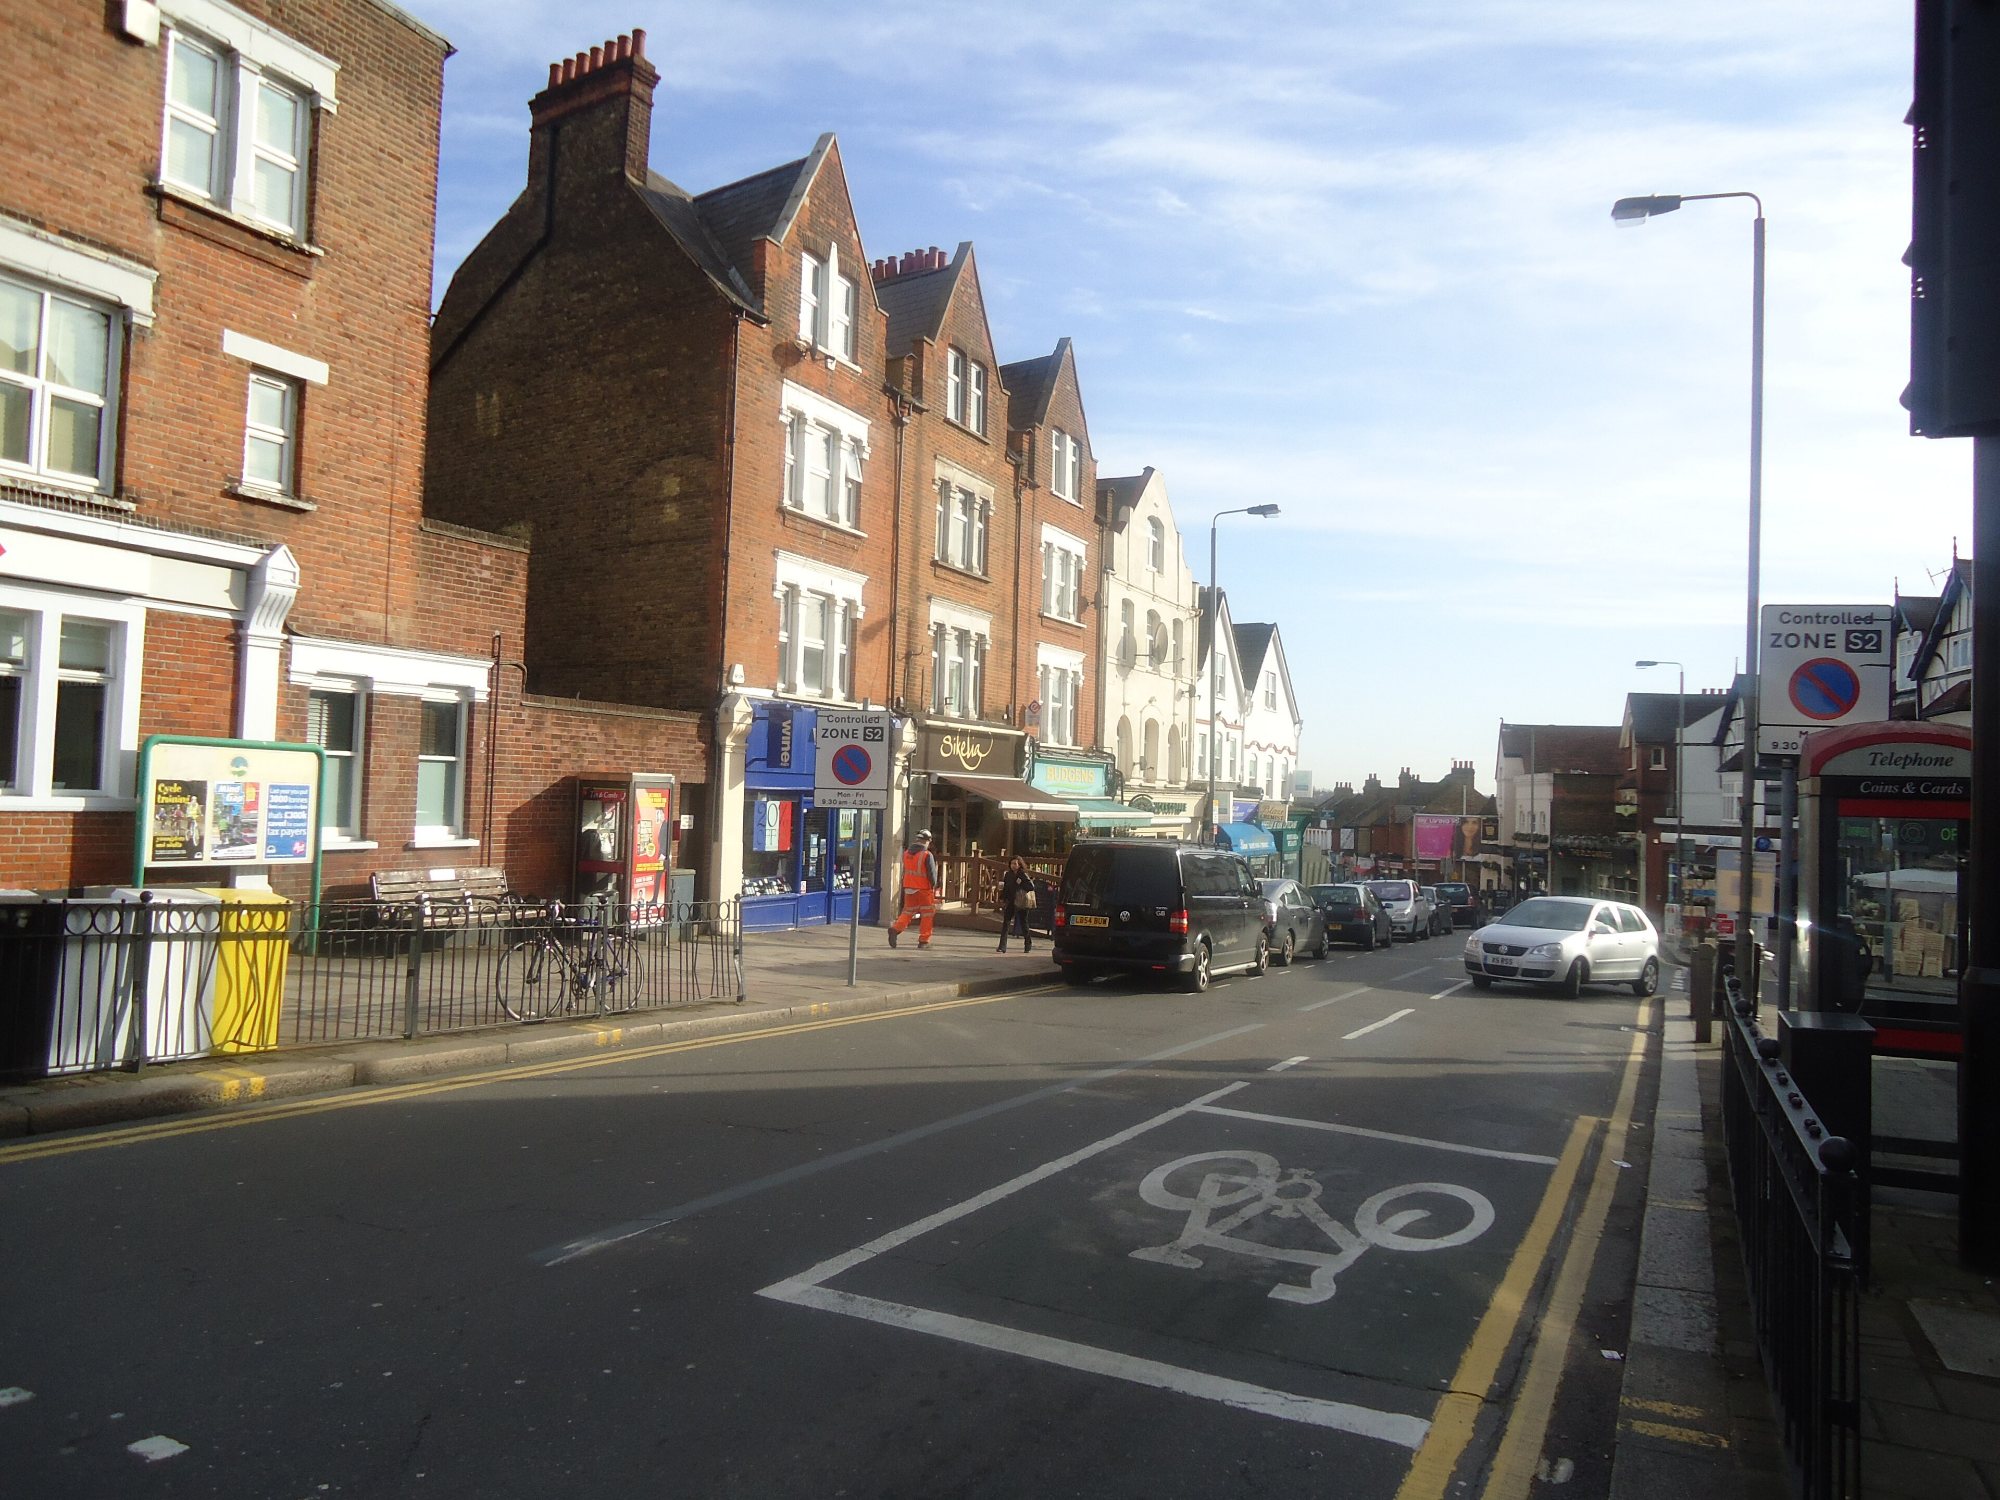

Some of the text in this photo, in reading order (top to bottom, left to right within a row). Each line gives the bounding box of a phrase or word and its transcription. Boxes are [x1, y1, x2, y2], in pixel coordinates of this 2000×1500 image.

[1779, 611, 1874, 625] Controlled
[1770, 631, 1880, 651] ZONE S2
[826, 714, 880, 724] Controlled
[821, 728, 883, 740] ZONE S2
[1771, 741, 1798, 750] 9.30
[1868, 751, 1954, 770] Telephone
[1046, 767, 1095, 784] BUDGENS
[158, 782, 182, 795] Cycle
[1859, 781, 1964, 795] Coins & Cards
[280, 828, 307, 838] payers
